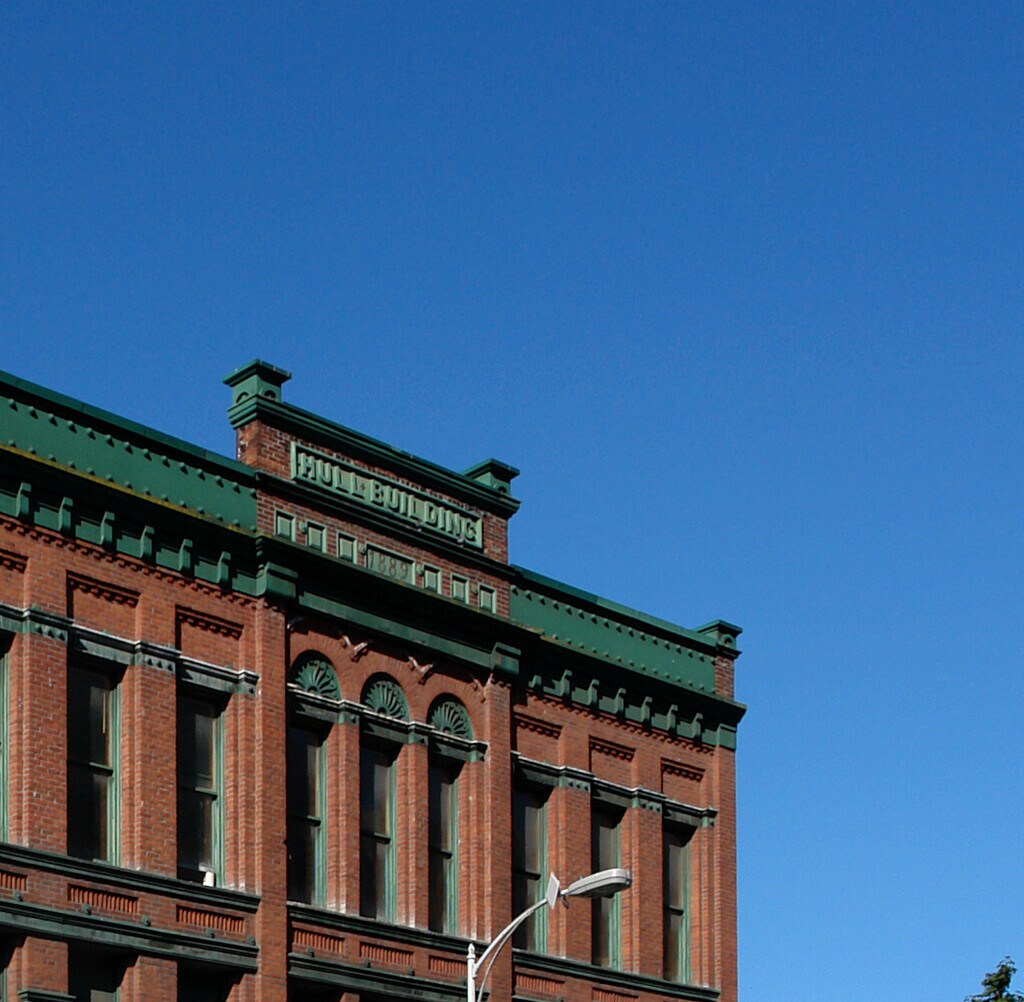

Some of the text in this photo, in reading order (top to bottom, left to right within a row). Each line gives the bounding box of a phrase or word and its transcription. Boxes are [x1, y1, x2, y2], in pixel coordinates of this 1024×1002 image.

[298, 453, 476, 541] HULL BUILDING
[368, 551, 408, 580] 1889
